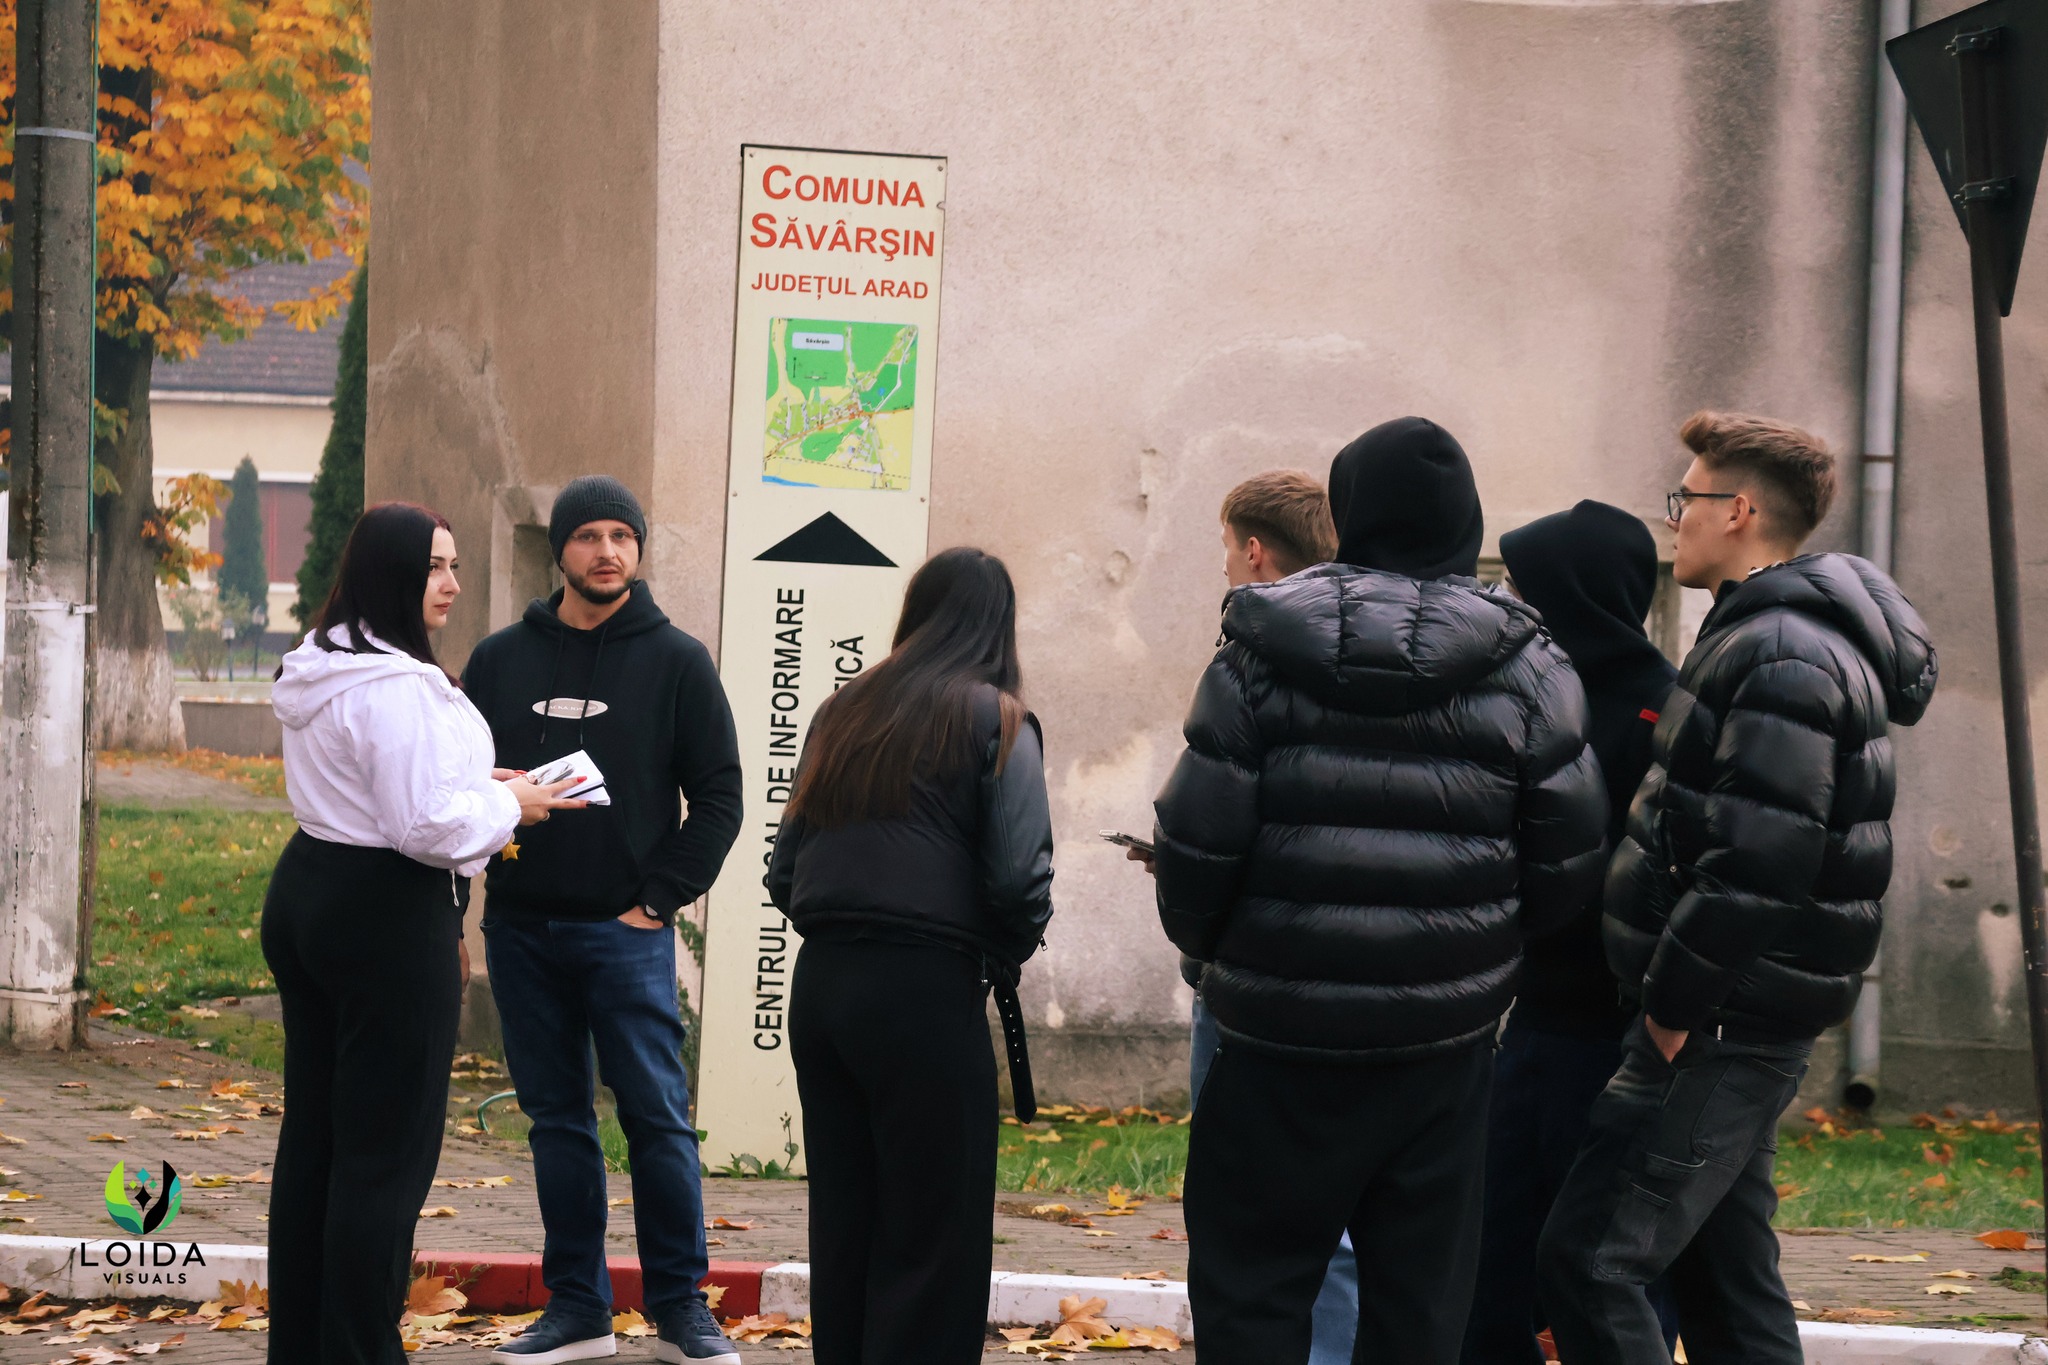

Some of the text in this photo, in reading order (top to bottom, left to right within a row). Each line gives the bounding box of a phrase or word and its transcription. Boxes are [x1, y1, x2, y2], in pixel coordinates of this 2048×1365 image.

[862, 278, 928, 299] ARAD
[769, 588, 805, 757] INFORMARE
[766, 766, 796, 803] DE
[753, 917, 788, 1051] CENTRUL
